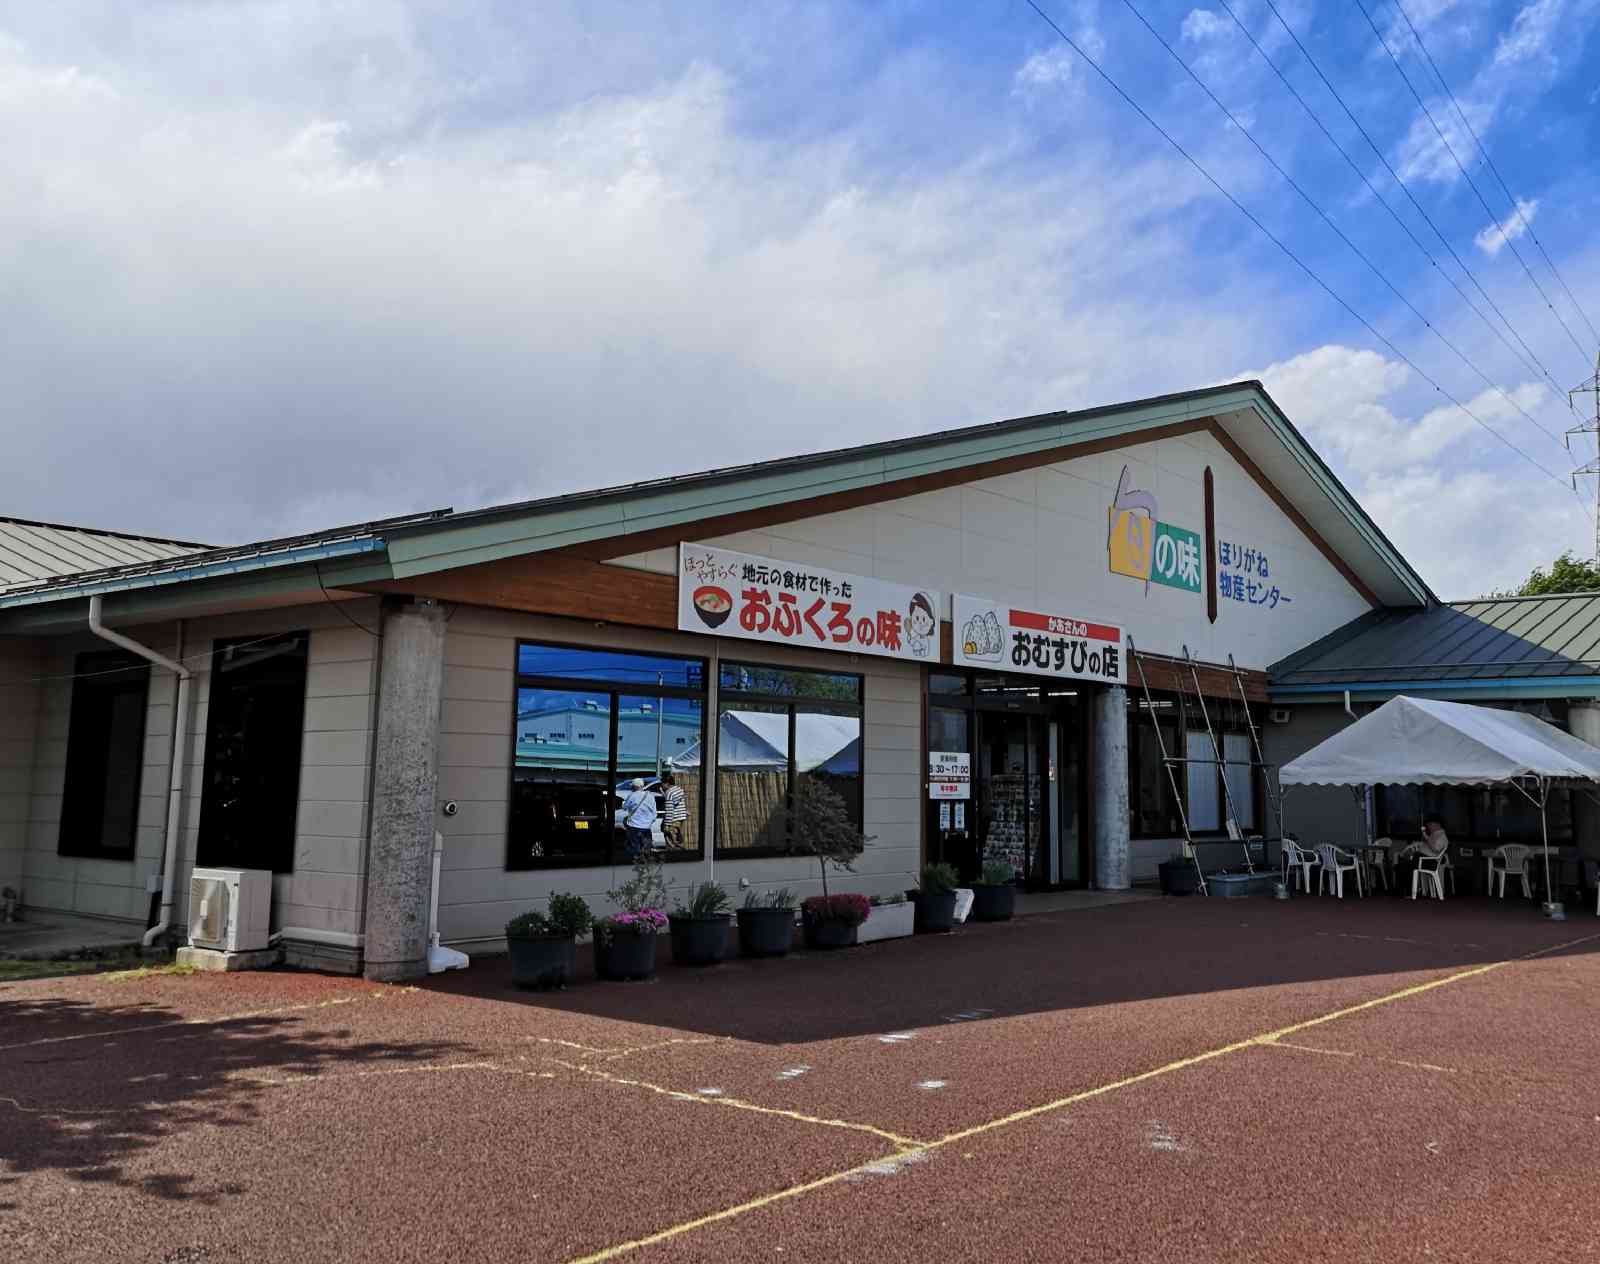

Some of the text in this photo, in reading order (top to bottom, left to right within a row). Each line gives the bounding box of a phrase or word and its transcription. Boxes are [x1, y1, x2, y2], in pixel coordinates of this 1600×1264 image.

[1219, 540, 1268, 577] ほりがね
[742, 564, 852, 598] 地元の食材で作った
[1219, 570, 1291, 609] 物産センター
[739, 587, 901, 650] おふくろの味
[1048, 616, 1088, 636] かあさんの
[1011, 631, 1119, 678] おむすびの店
